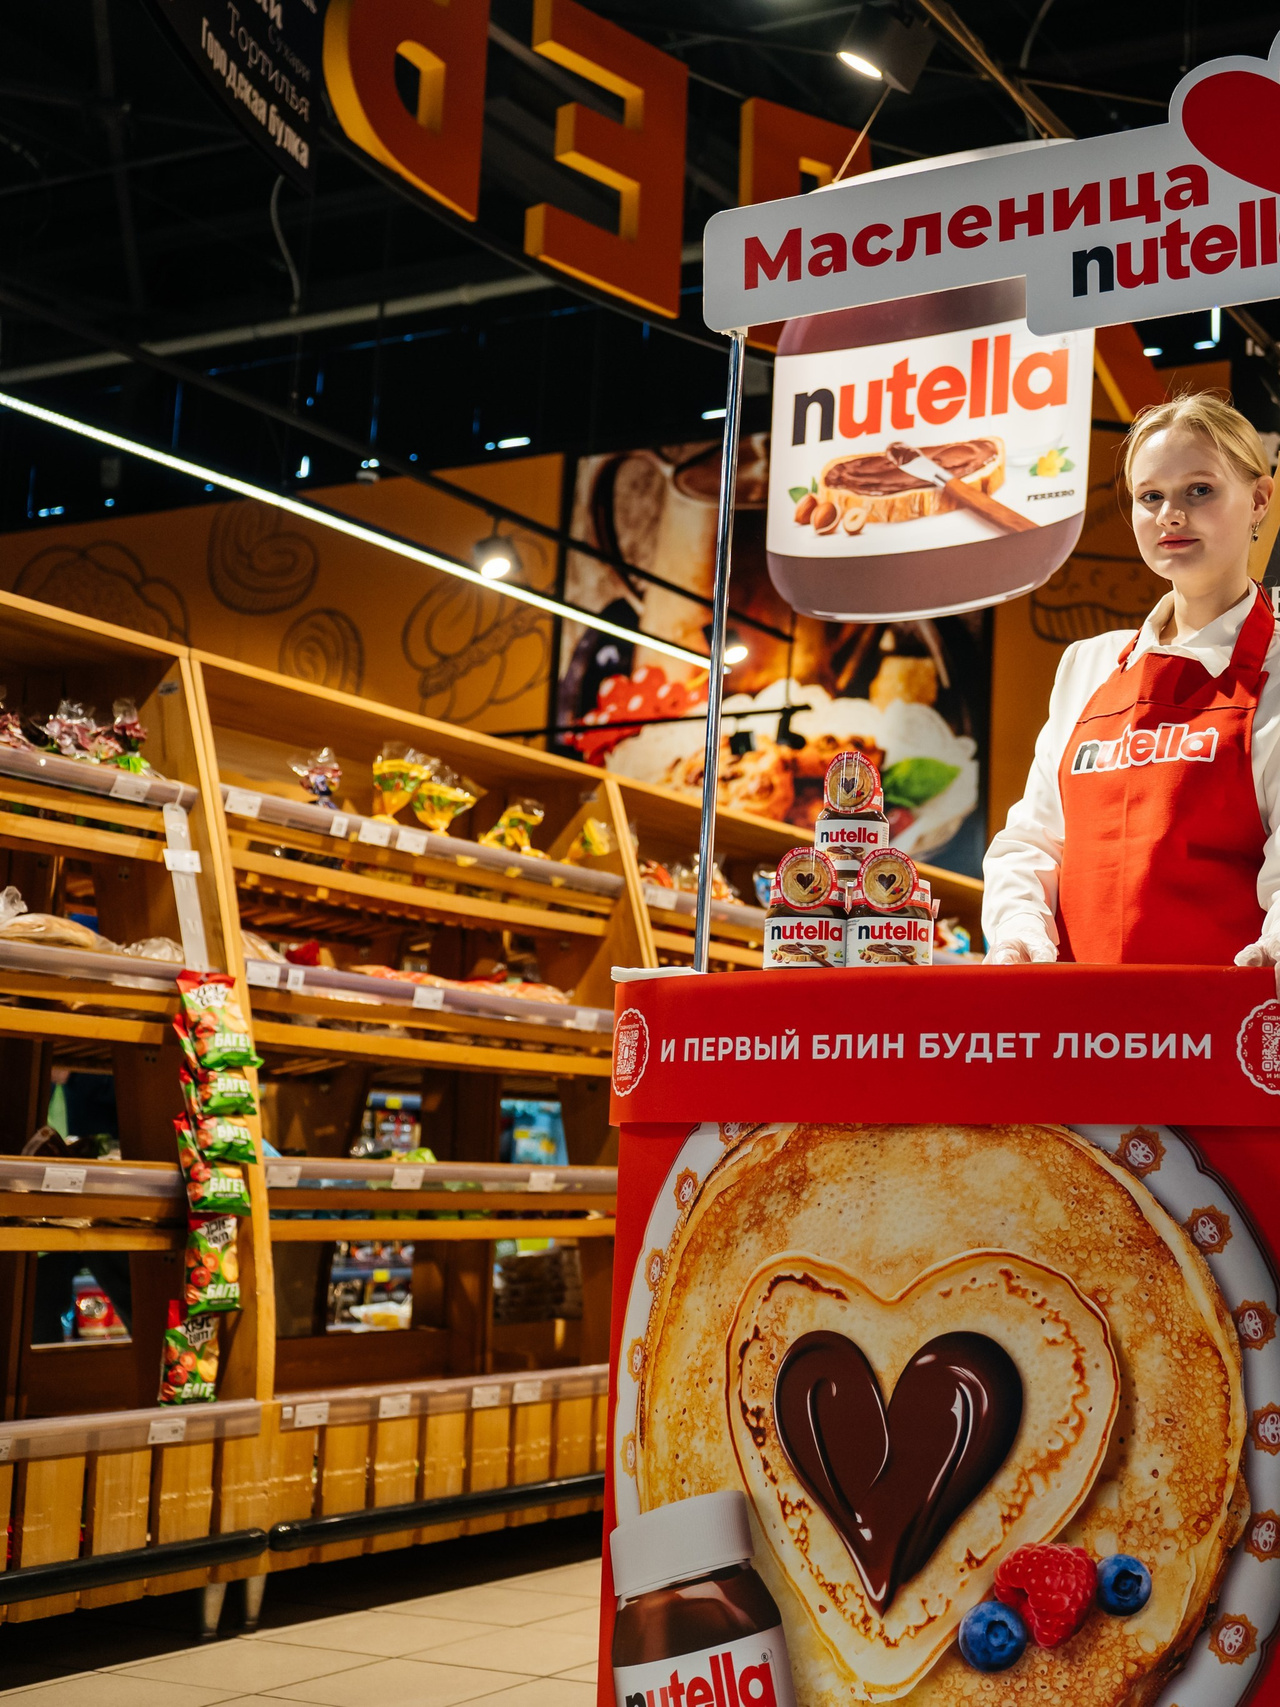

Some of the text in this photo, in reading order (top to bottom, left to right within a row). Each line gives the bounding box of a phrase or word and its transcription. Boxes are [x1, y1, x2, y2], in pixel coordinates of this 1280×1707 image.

[744, 163, 1209, 290] Масленица
[791, 334, 1069, 446] nutella
[1026, 489, 1075, 502] FERRERO
[1073, 724, 1216, 771] nutella
[821, 827, 879, 844] nutella
[891, 848, 908, 861] будет
[771, 920, 843, 941] nutella
[858, 920, 929, 943] nutella
[660, 1028, 1212, 1063] И ПЕРВЫЙ БЛИН БУДЕТ ЛЮБИМ
